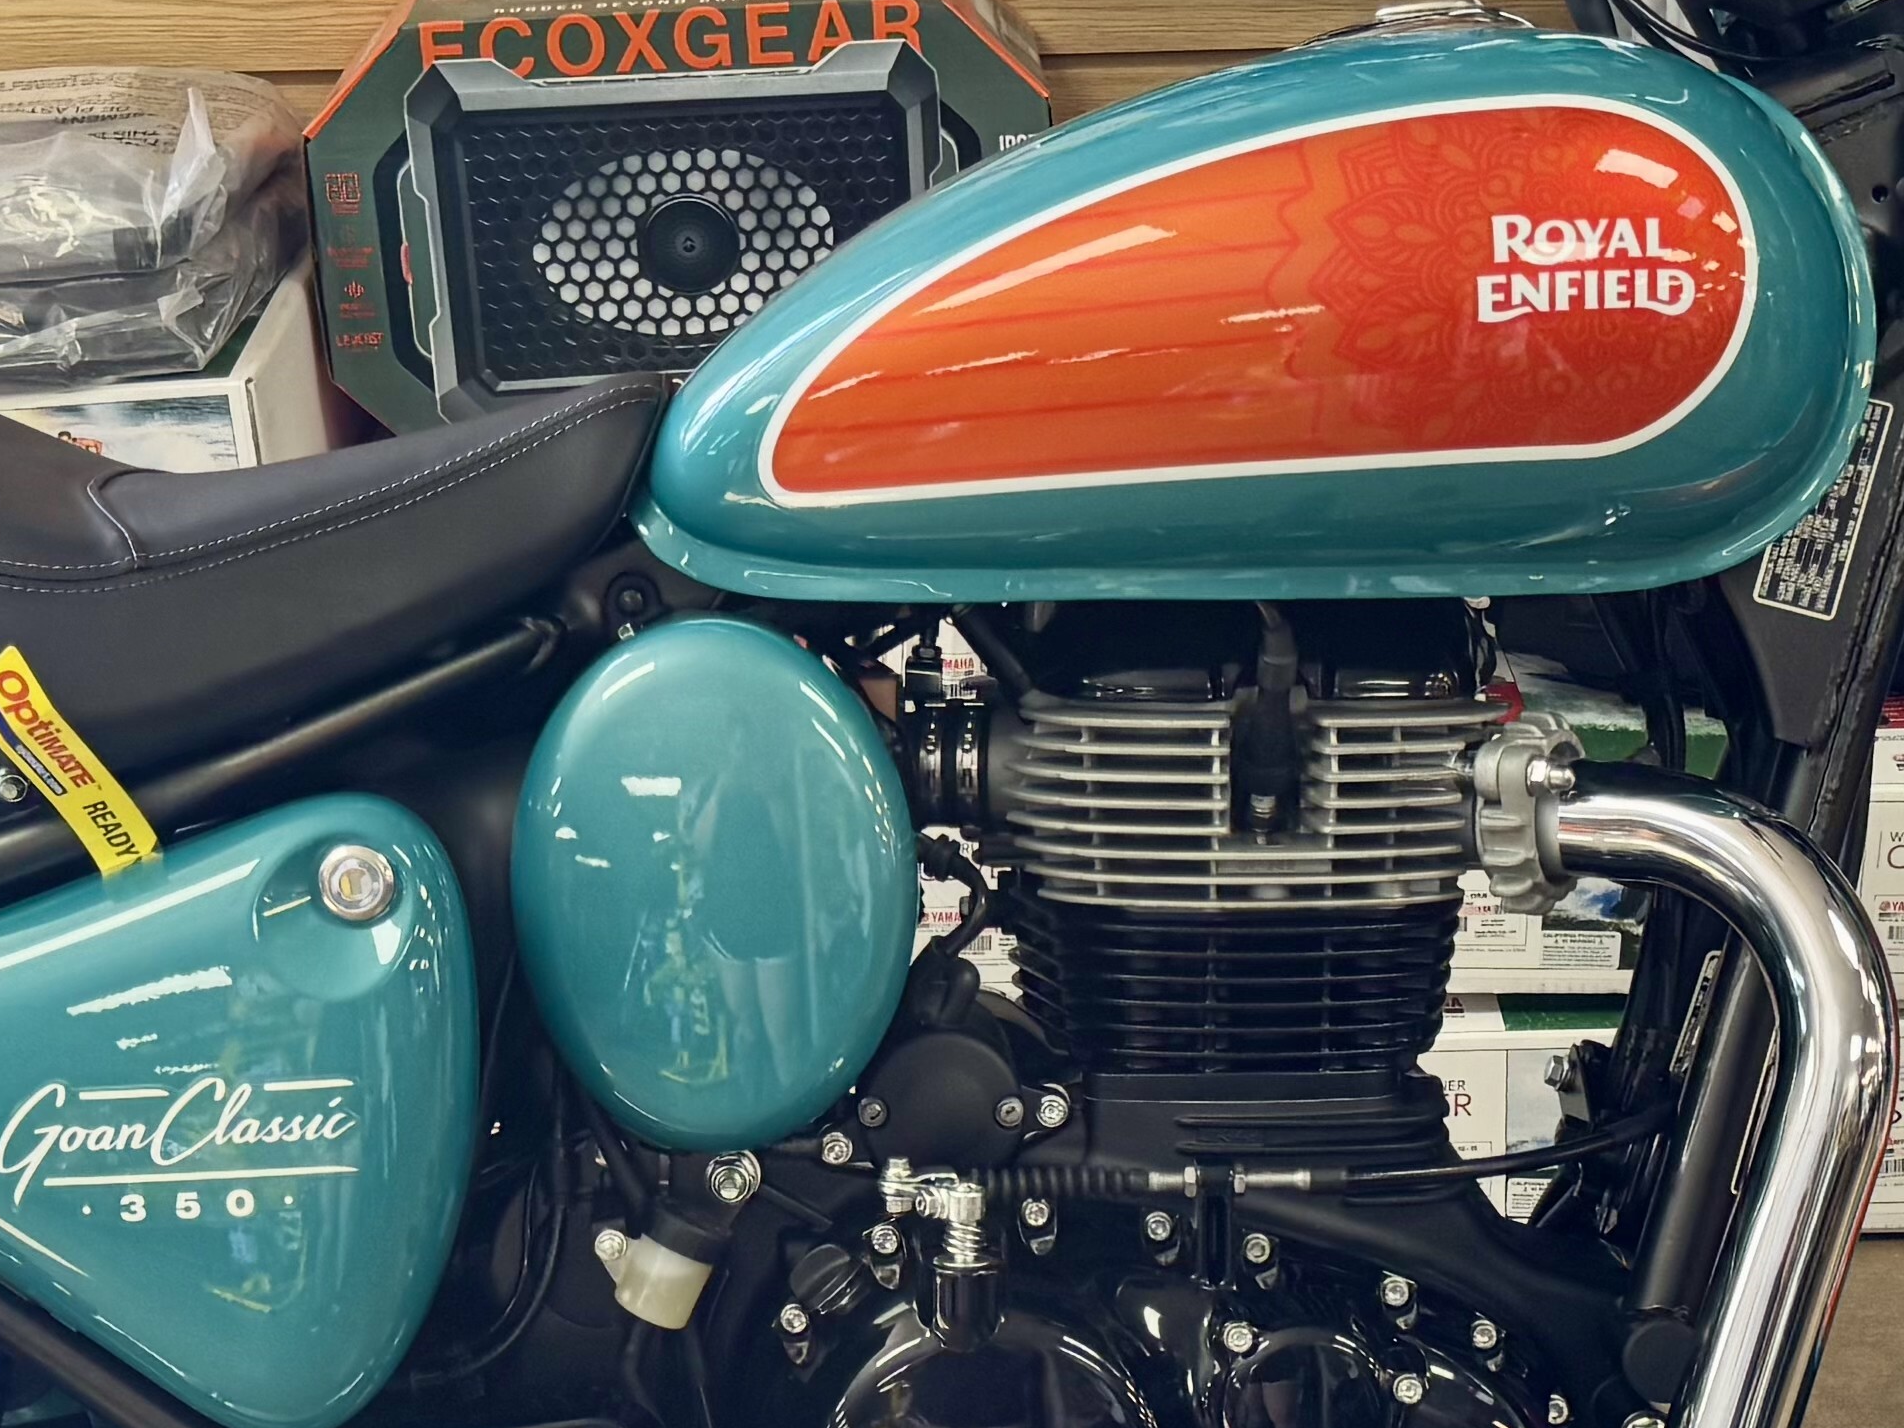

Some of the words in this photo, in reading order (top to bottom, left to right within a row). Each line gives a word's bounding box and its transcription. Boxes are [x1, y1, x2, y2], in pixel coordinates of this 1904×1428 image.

[1491, 215, 1672, 265] ROYAL
[1477, 269, 1695, 323] ENFIELD
[83, 801, 140, 857] READY
[150, 1077, 357, 1166] Classic
